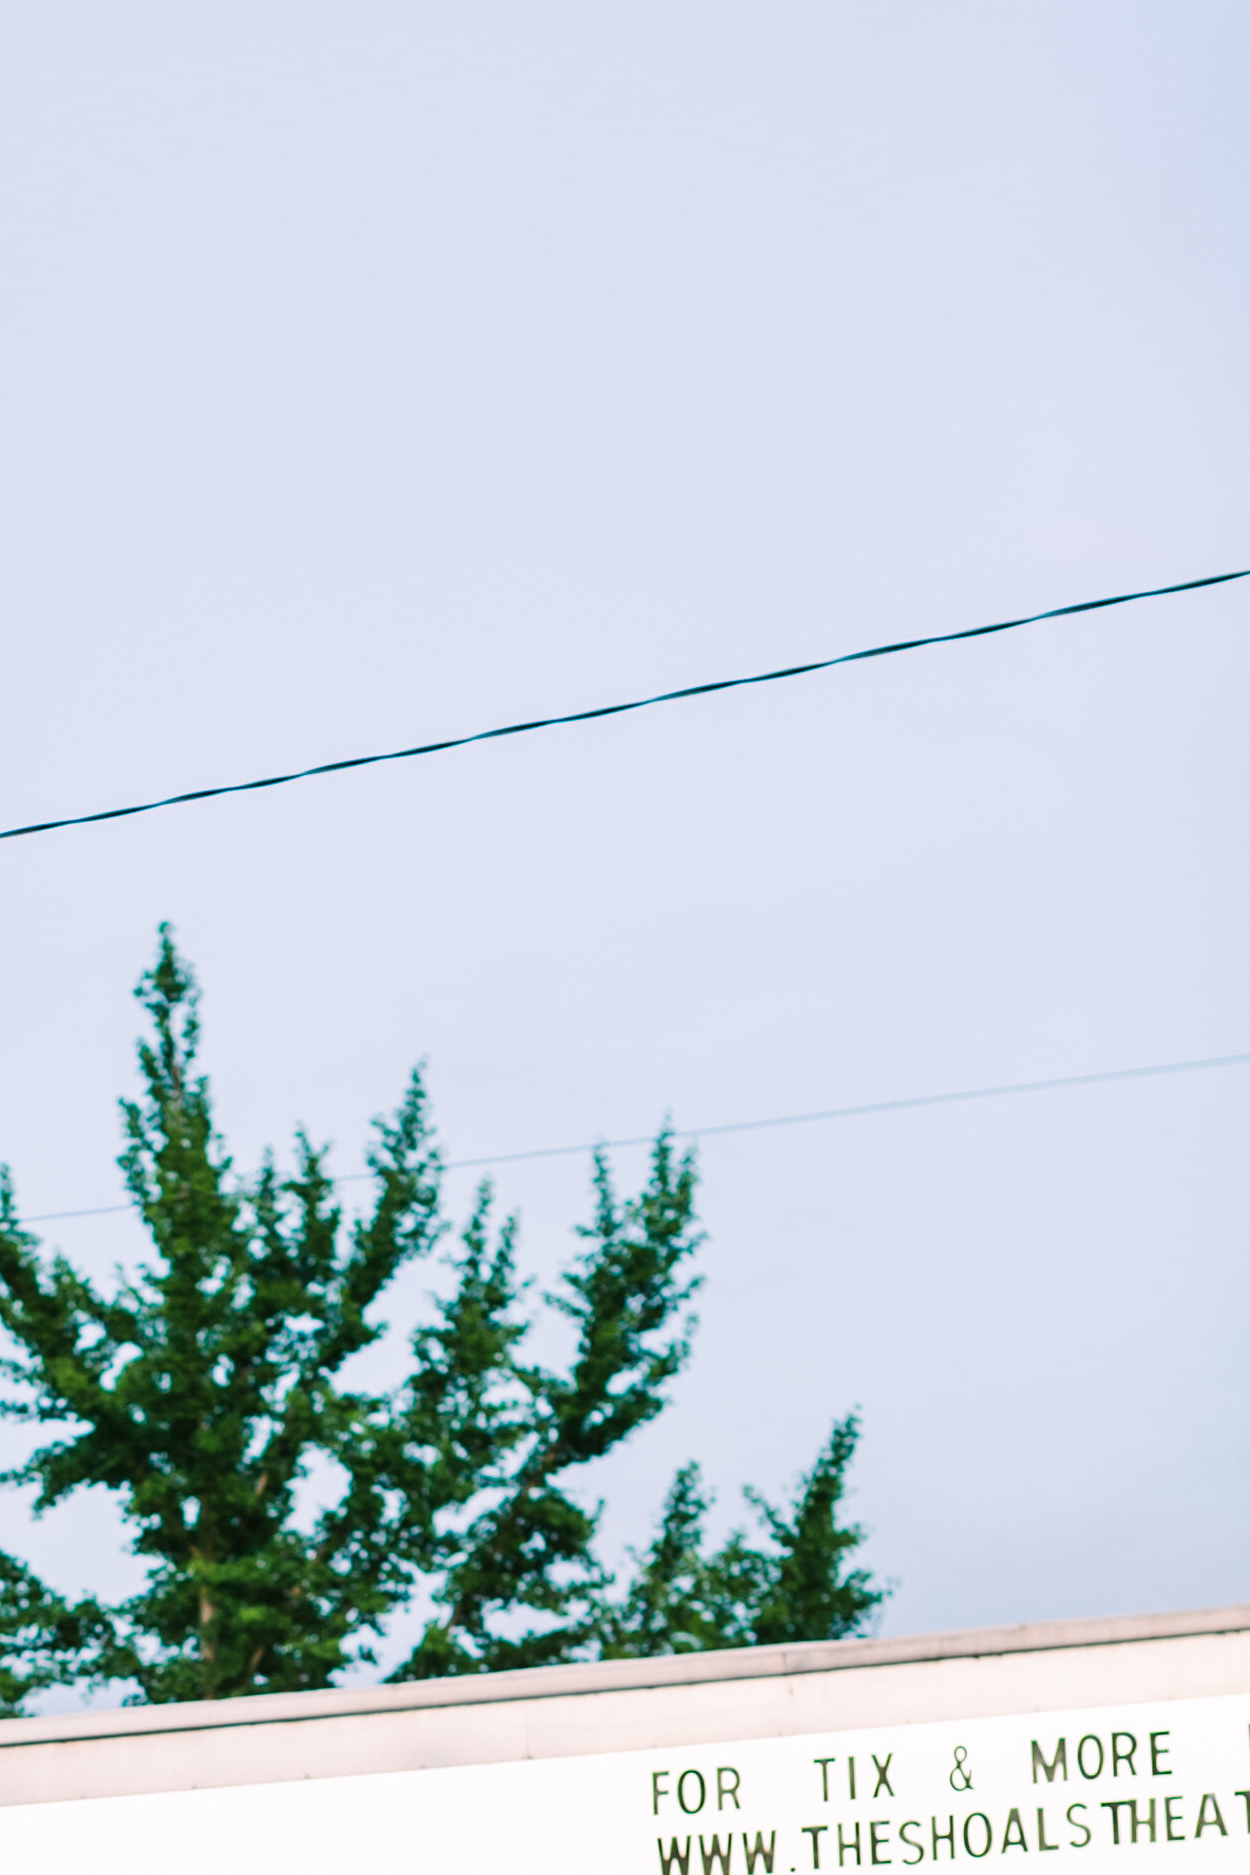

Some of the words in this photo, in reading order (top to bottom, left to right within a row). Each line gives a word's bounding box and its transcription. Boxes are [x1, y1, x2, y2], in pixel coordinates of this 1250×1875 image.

[651, 1765, 742, 1817] FOR
[812, 1751, 896, 1803] TIX
[949, 1745, 975, 1793] &
[1029, 1730, 1174, 1785] MORE
